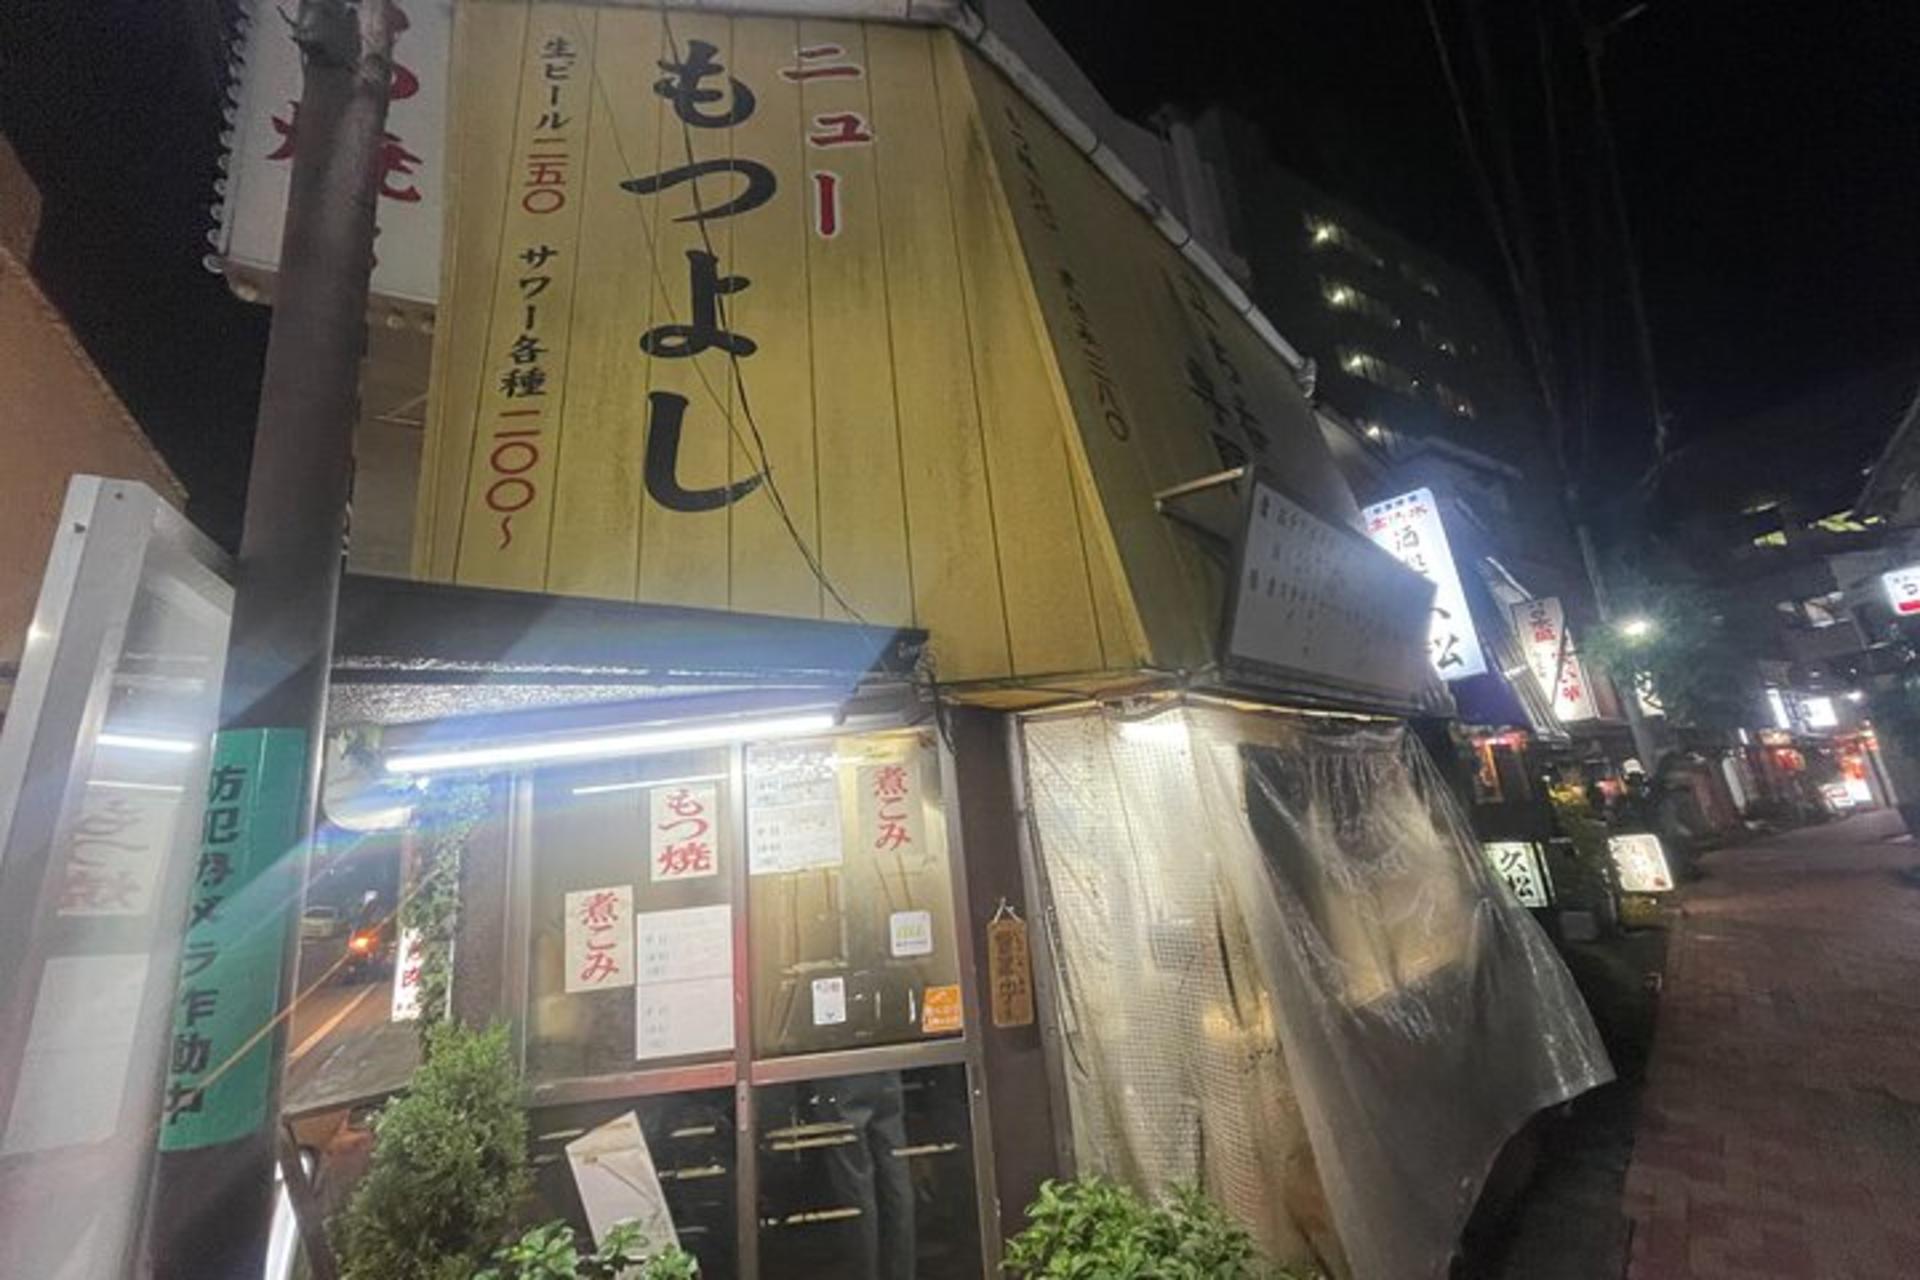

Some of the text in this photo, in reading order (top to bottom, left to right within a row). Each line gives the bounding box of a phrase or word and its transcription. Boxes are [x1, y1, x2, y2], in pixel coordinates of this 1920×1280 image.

[782, 46, 873, 237] ニュー
[620, 40, 777, 513] もつよし
[657, 788, 712, 875] もつ焼
[874, 766, 911, 852] 煮こみ
[580, 892, 620, 982] 煮こみ
